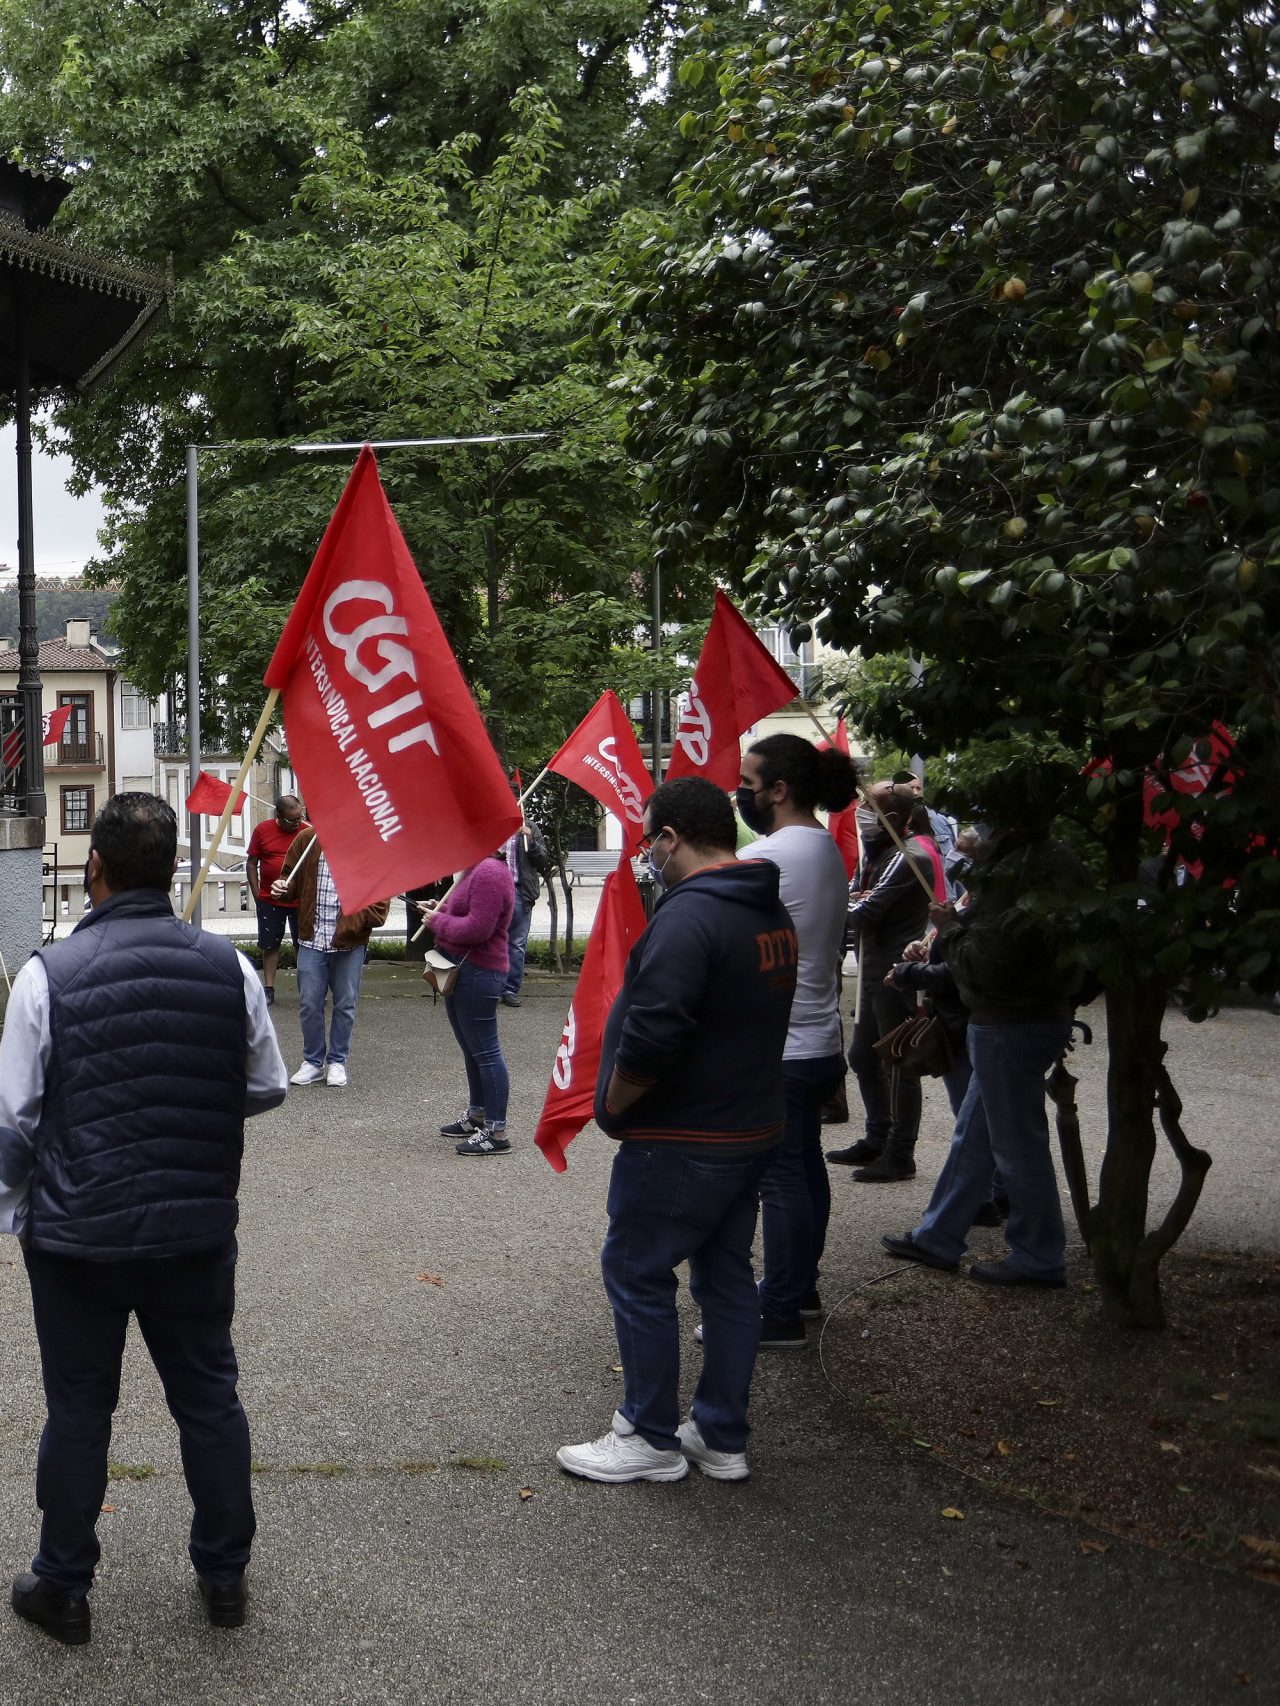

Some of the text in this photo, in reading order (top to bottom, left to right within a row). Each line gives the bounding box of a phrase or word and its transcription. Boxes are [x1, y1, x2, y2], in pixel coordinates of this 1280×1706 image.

[306, 634, 402, 841] NTERSINDICAL NACIONAL
[582, 754, 625, 805] INTERSINDICAL
